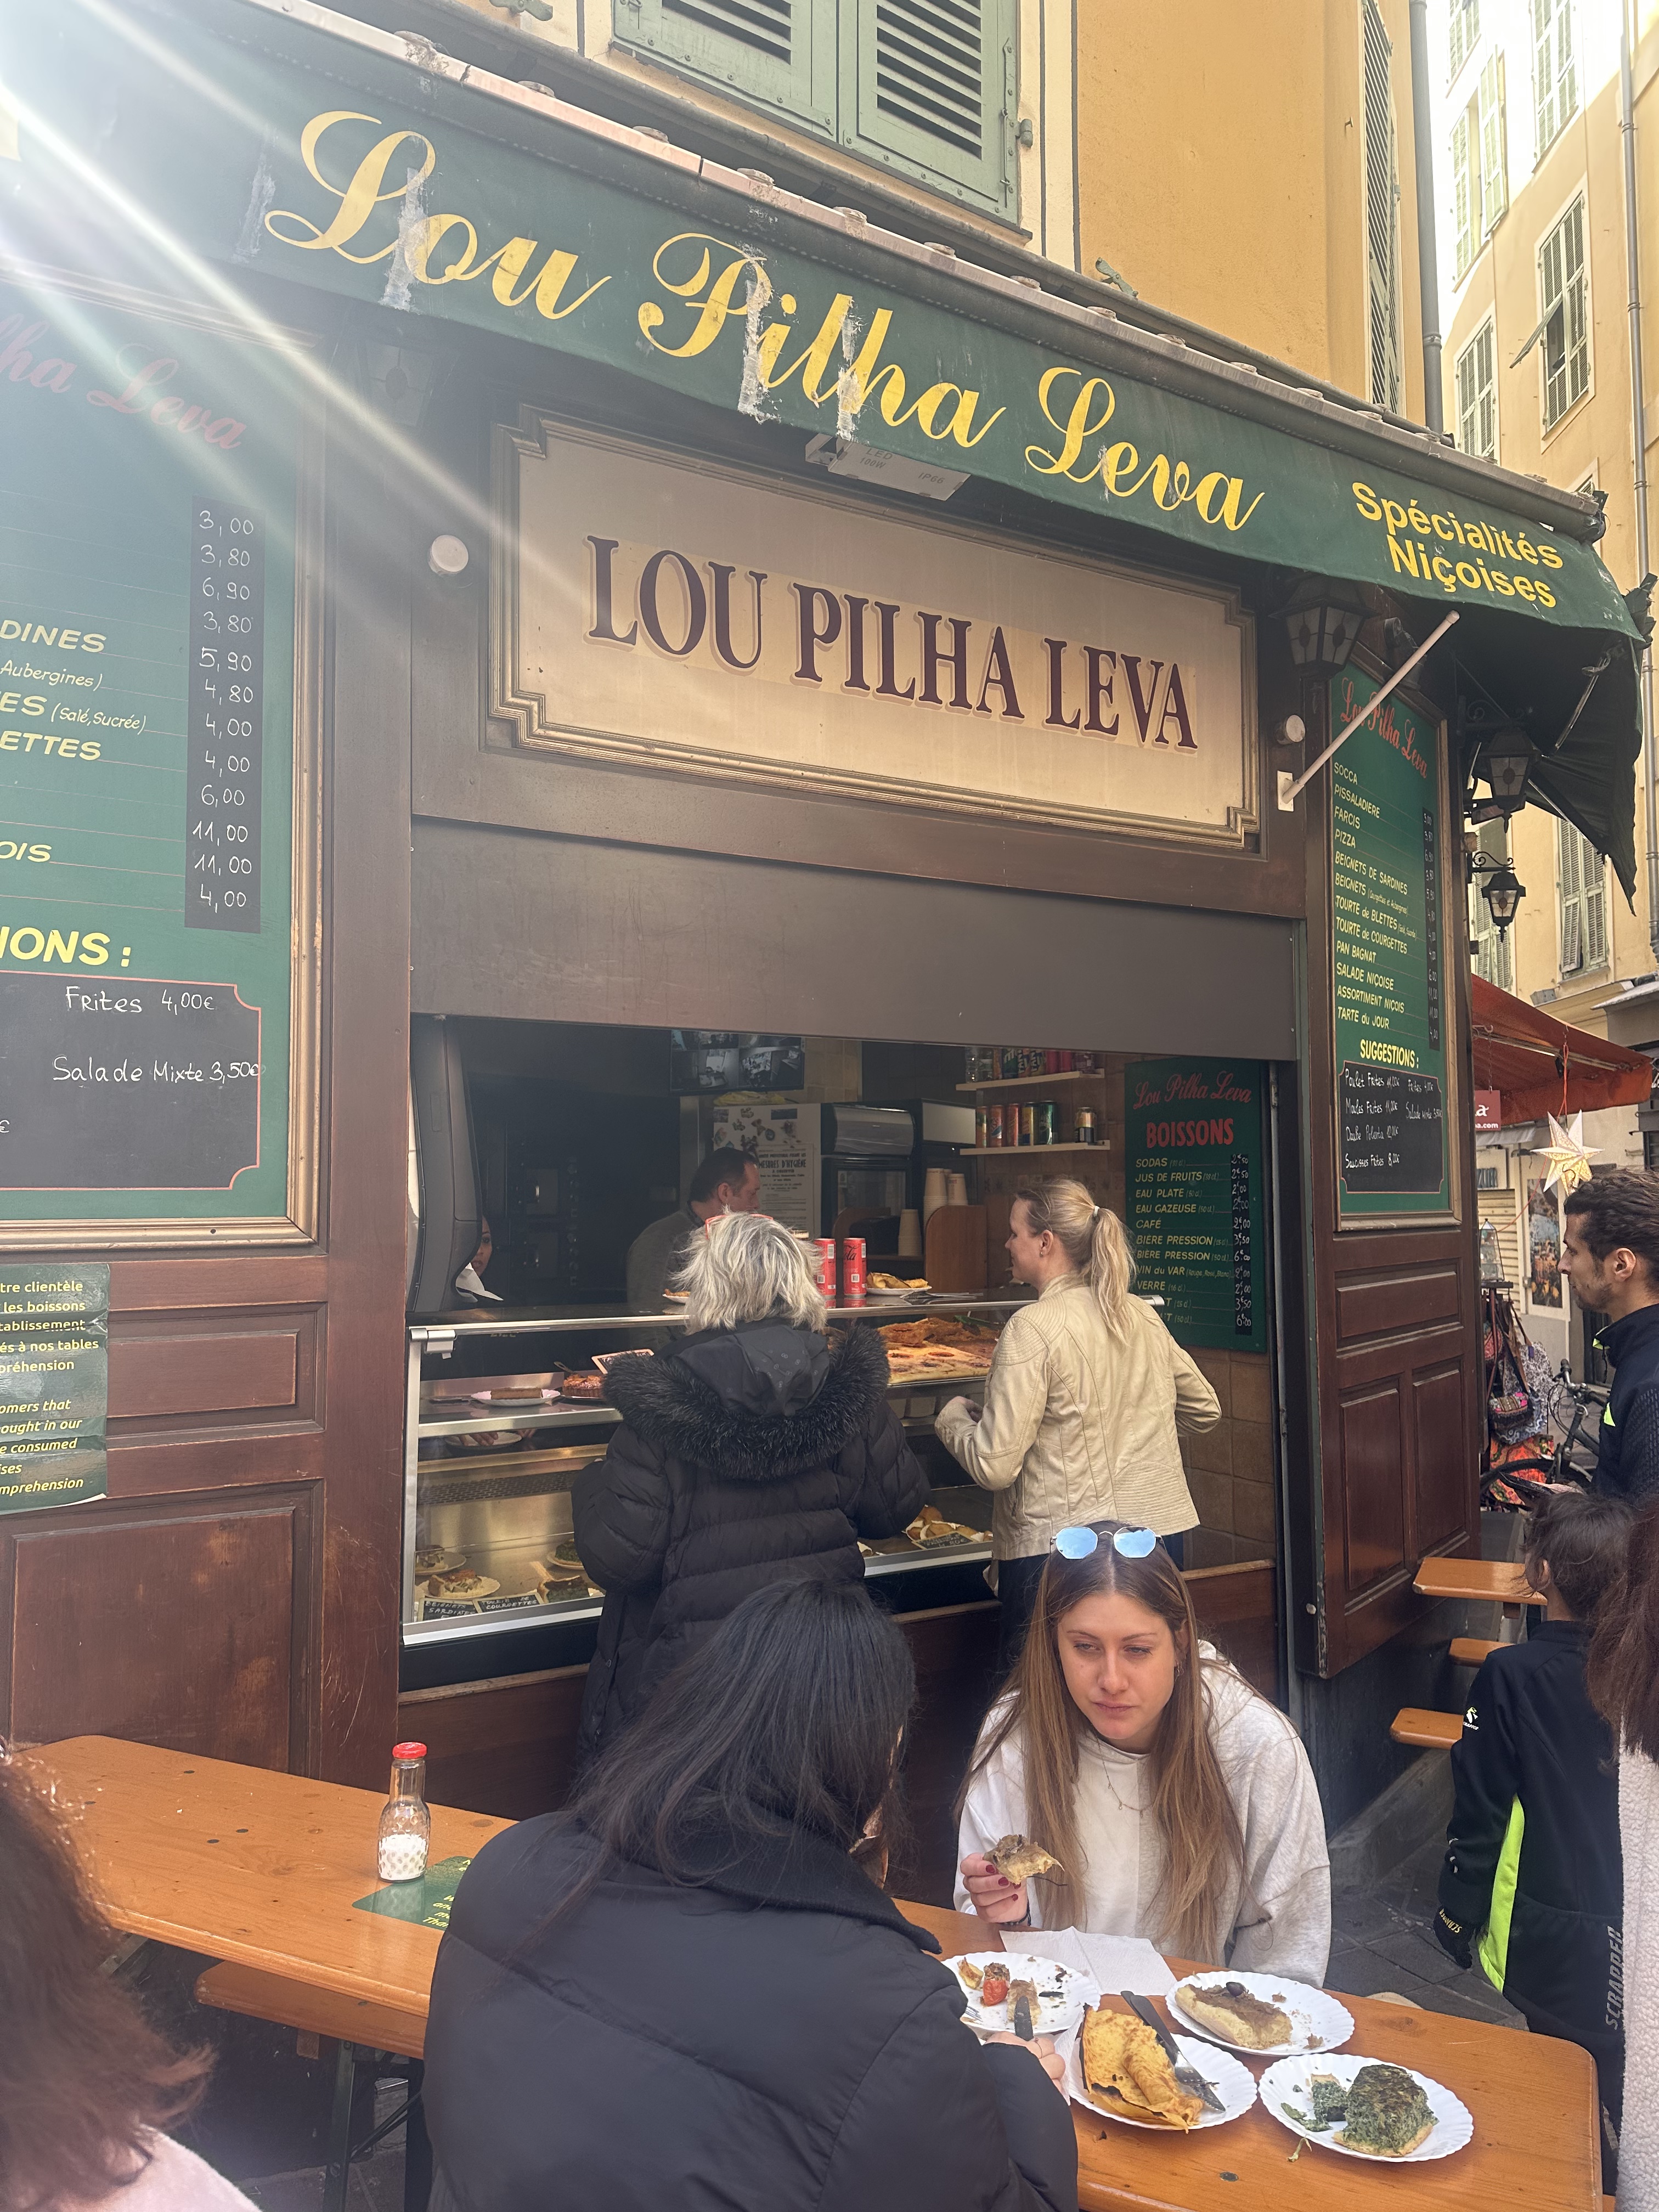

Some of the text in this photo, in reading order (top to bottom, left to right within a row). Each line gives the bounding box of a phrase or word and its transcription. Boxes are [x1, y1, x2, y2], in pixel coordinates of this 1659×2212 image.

[264, 111, 1265, 530] Lou Pilha Leva
[86, 342, 247, 449] Leva
[859, 456, 887, 469] 100W
[918, 472, 945, 484] IP66
[199, 510, 254, 537] 3,00
[1352, 482, 1564, 569] Spécialités
[200, 544, 250, 568] 3,80
[1387, 534, 1556, 608] Niçoises
[202, 577, 250, 601] 6,90
[204, 611, 251, 634] 3,80
[586, 535, 1198, 749] LOU PILHA LEVA
[199, 647, 252, 672] 5,90
[205, 678, 253, 706] 4,80
[206, 713, 252, 739] 4,00
[1401, 719, 1427, 779] Leva
[205, 750, 250, 777] 4,00
[1334, 761, 1358, 785] SOCCA
[201, 784, 245, 808] 6,00
[1334, 783, 1380, 819] PISSALADIERE
[1334, 805, 1361, 829] FARCIS
[192, 820, 248, 847] 11,00
[1334, 828, 1356, 849] PIZZA
[194, 854, 252, 876] 11,00
[1335, 850, 1408, 895] BEIGNETS DE SARDINES
[1335, 872, 1367, 896] BEIGNETS
[200, 883, 246, 913] 4,00
[1335, 895, 1397, 930] TOURTE de BLETTES
[1336, 916, 1361, 938] TOURTE
[1362, 927, 1369, 940] de
[1371, 930, 1408, 955] COURGETTES
[1336, 940, 1376, 964] PAN BAGNAT
[1336, 962, 1395, 991] SALADE NIÇOISE
[161, 989, 215, 1015] 4,00€
[1337, 985, 1405, 1014] ASSORTIMENT NIÇOIS
[1338, 1006, 1390, 1030] TARTE du JOUR
[53, 1055, 259, 1084] Salade Mixte 3,50€
[1345, 1068, 1365, 1088] Poulet
[1133, 1070, 1252, 1110] Lou Pilha Leva
[1345, 1097, 1364, 1115] Moules
[1147, 1118, 1234, 1149] BOISSONS
[1365, 1124, 1385, 1141] Polenta
[1135, 1158, 1168, 1168] SODAS
[1345, 1153, 1369, 1169] Saucisses
[1135, 1173, 1154, 1183] JUS
[1156, 1172, 1168, 1182] DE
[1170, 1171, 1203, 1182] FRUITS
[1136, 1189, 1152, 1198] EAU
[1156, 1188, 1184, 1198] PLATE
[1136, 1204, 1152, 1214] EAU
[1155, 1204, 1197, 1214] GAZEUSE
[1136, 1218, 1162, 1229] CAFÉ
[1136, 1234, 1163, 1245] BIÈRE
[1166, 1235, 1214, 1245] PRESSION
[1136, 1249, 1161, 1259] BIÈRE
[1165, 1251, 1211, 1261] PRESSION
[1137, 1265, 1152, 1274] VIN
[1154, 1266, 1165, 1275] du
[1167, 1266, 1185, 1276] VAR
[24, 1280, 83, 1293] clientèle
[1137, 1281, 1166, 1291] VERRE
[4, 1300, 86, 1313] les boissons
[18, 1340, 25, 1352] à
[30, 1342, 54, 1352] nos
[58, 1339, 99, 1351] tables
[43, 1399, 71, 1412] that
[44, 1420, 56, 1431] in
[60, 1420, 83, 1431] our
[10, 1437, 78, 1454] consumed
